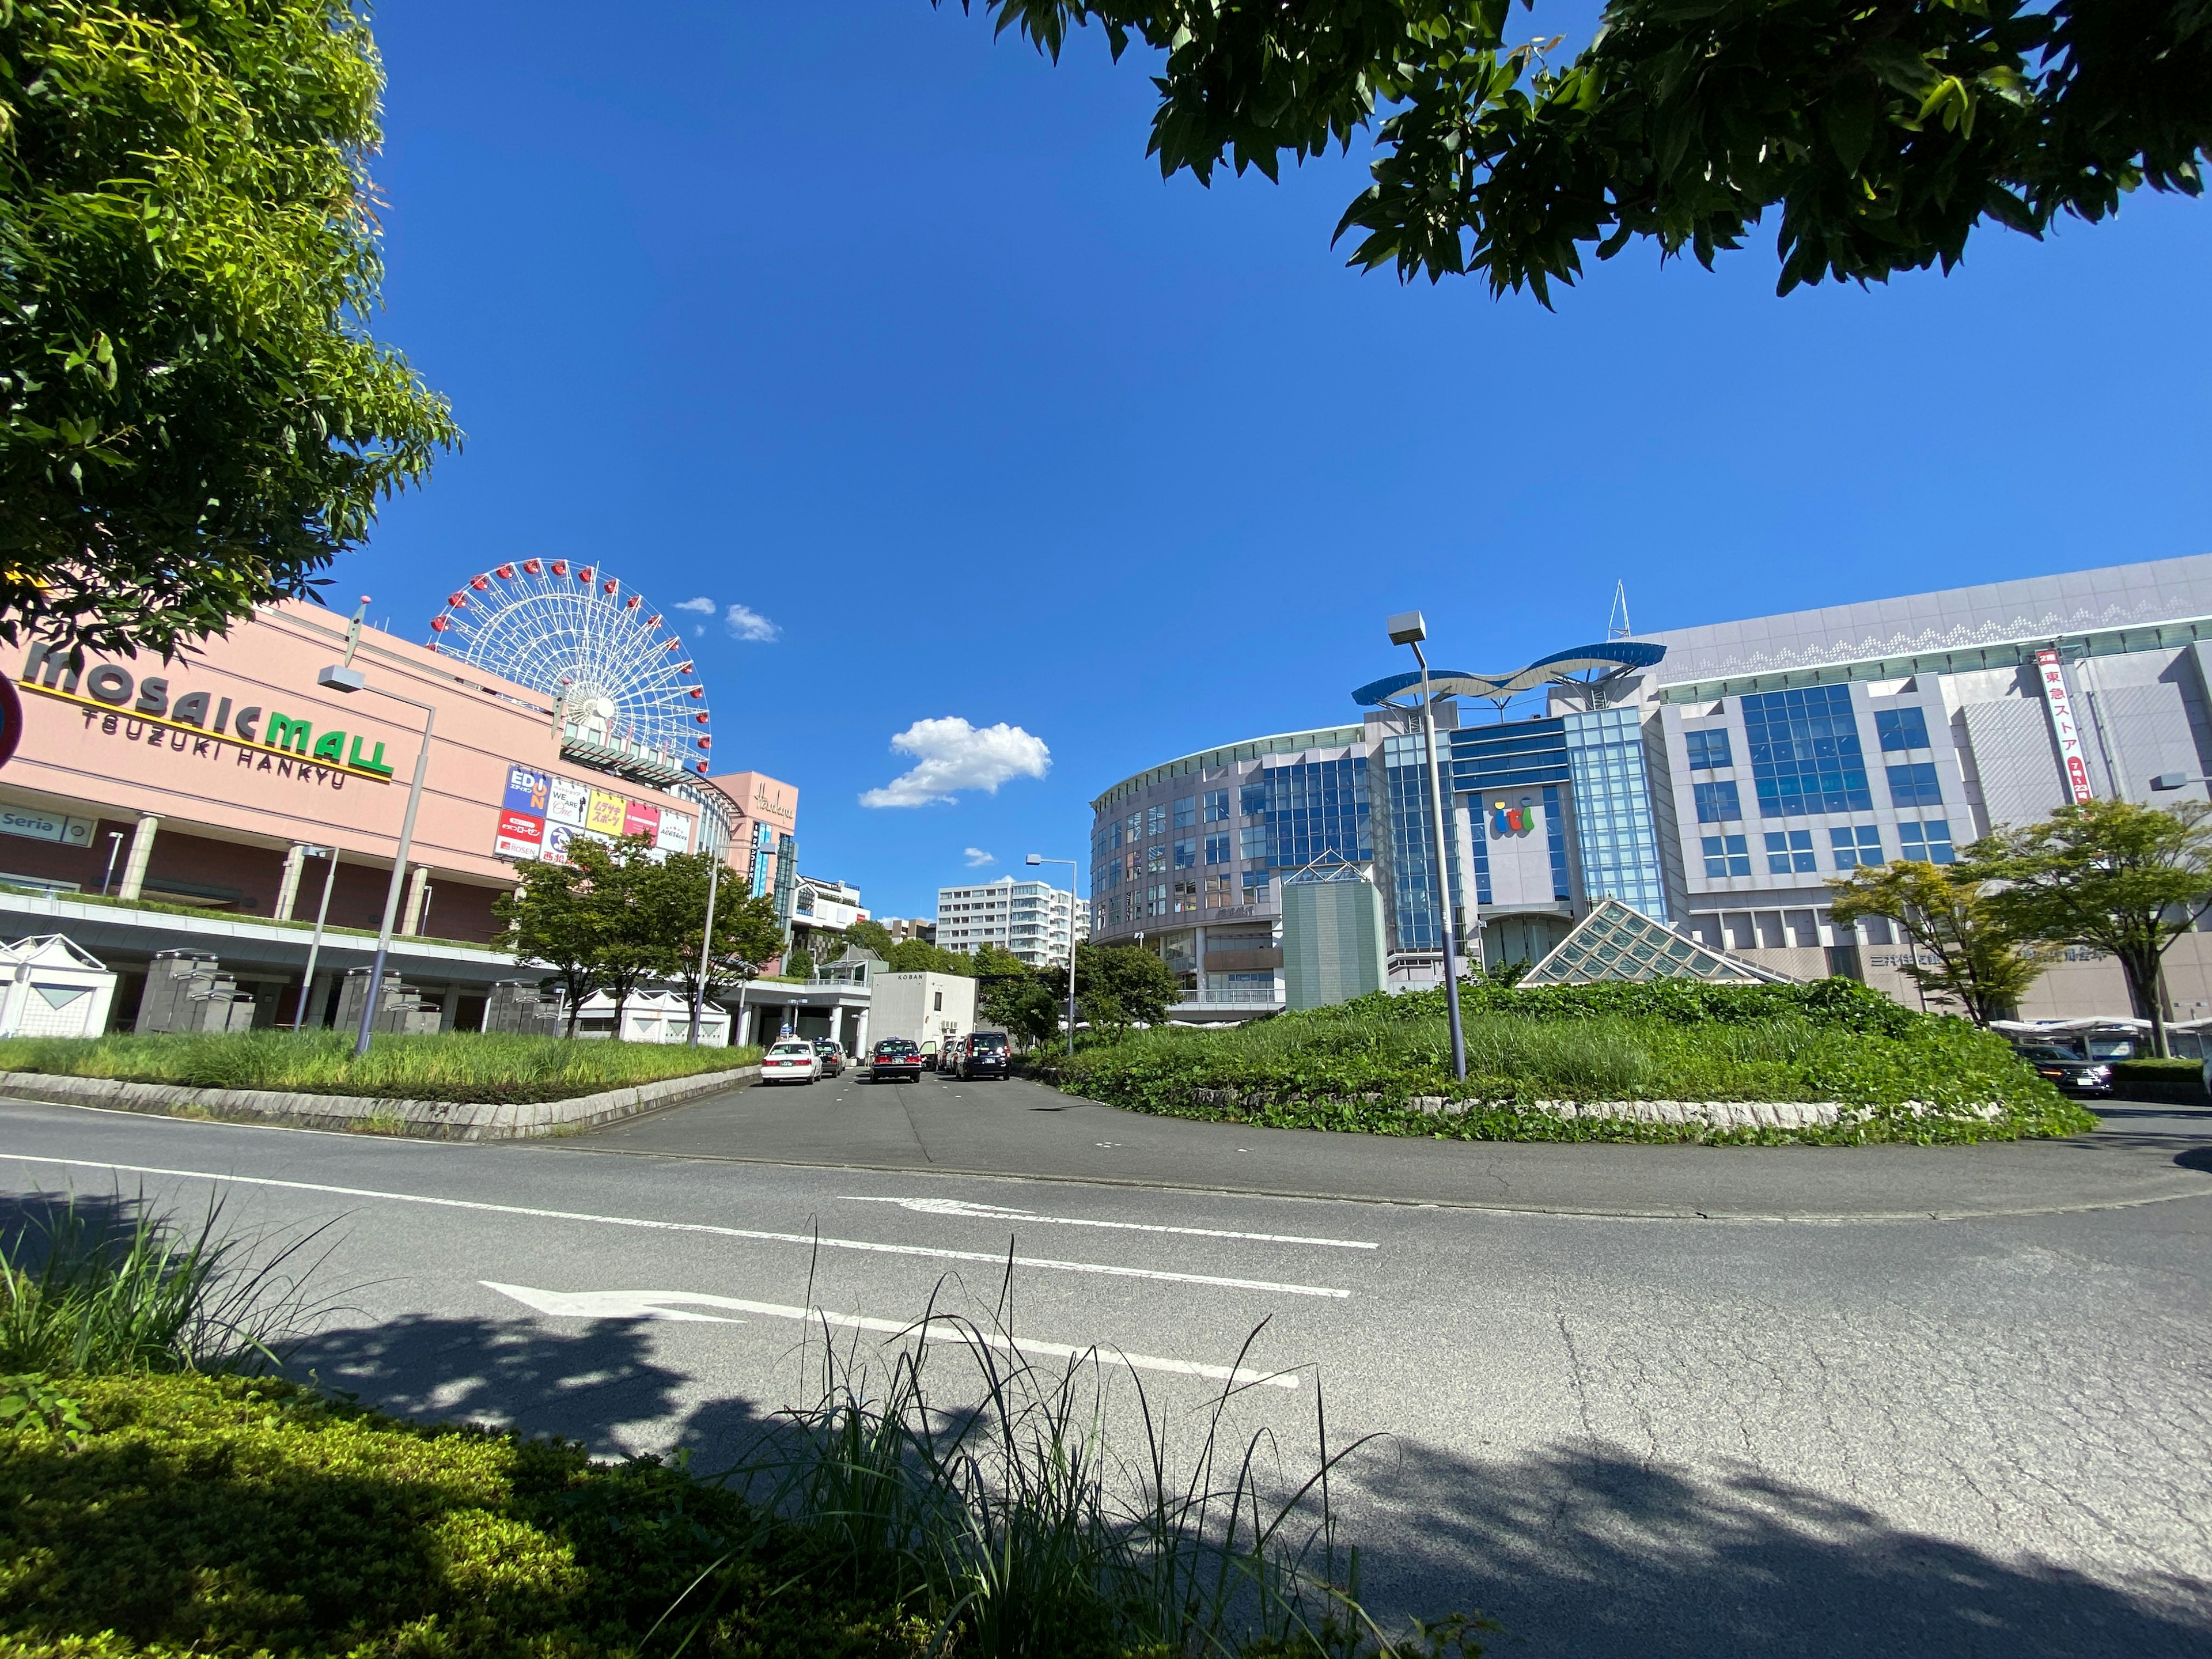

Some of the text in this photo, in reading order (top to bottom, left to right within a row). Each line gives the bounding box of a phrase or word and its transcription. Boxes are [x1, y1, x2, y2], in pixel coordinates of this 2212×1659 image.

[2044, 671, 2077, 750] 東急ストア
[82, 707, 346, 790] TSUZUKI HANKYU
[510, 783, 532, 793] エディオン
[554, 786, 581, 796] ペットショップ
[553, 791, 566, 800] WE
[565, 800, 578, 808] ARE
[594, 801, 621, 816] ムラサキ
[754, 783, 793, 824] Hankyu
[2, 813, 53, 831] Seria
[592, 812, 620, 826] スポーツ
[510, 843, 535, 855] ROSEN
